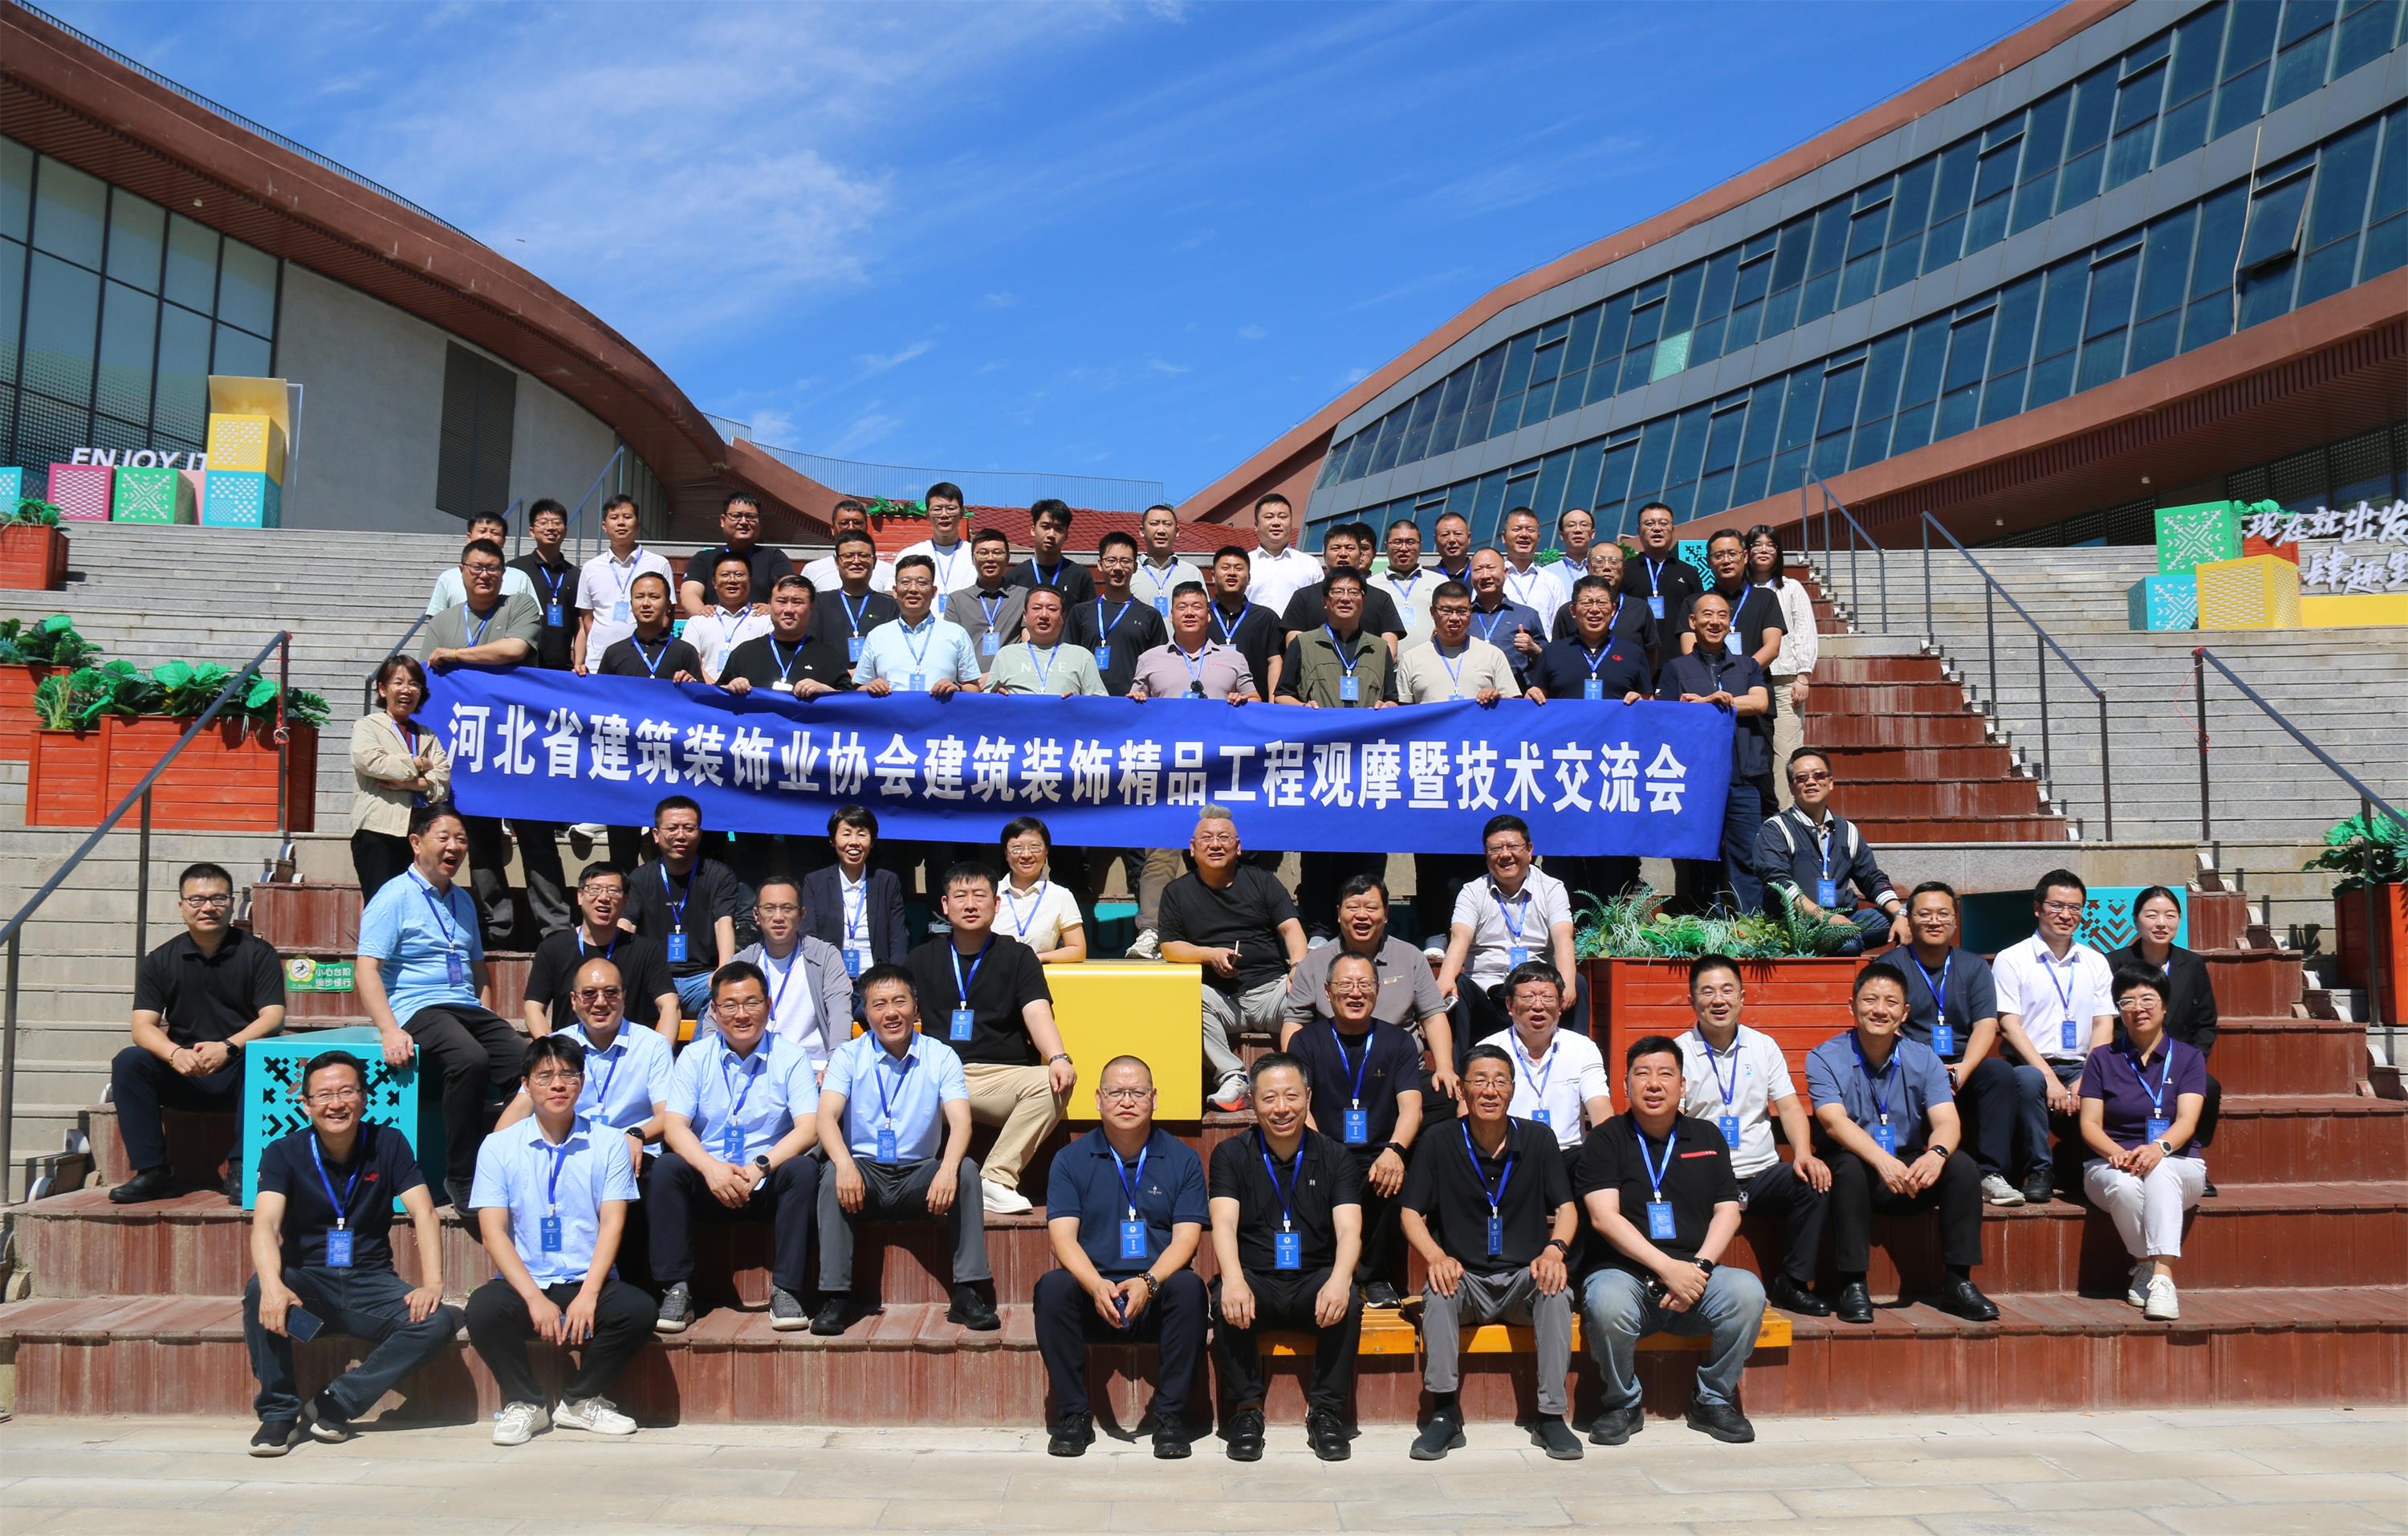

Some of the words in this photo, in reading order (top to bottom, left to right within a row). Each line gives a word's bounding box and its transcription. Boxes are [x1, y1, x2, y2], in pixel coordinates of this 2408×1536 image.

[71, 446, 181, 469] ENJOY
[2246, 499, 2408, 548] 现在就出发
[1021, 662, 1067, 673] NKE
[447, 701, 1687, 815] 河北省建筑装饰业协会建筑装饰精品工程观摩暨技术交流会
[315, 968, 351, 976] 小心台阶
